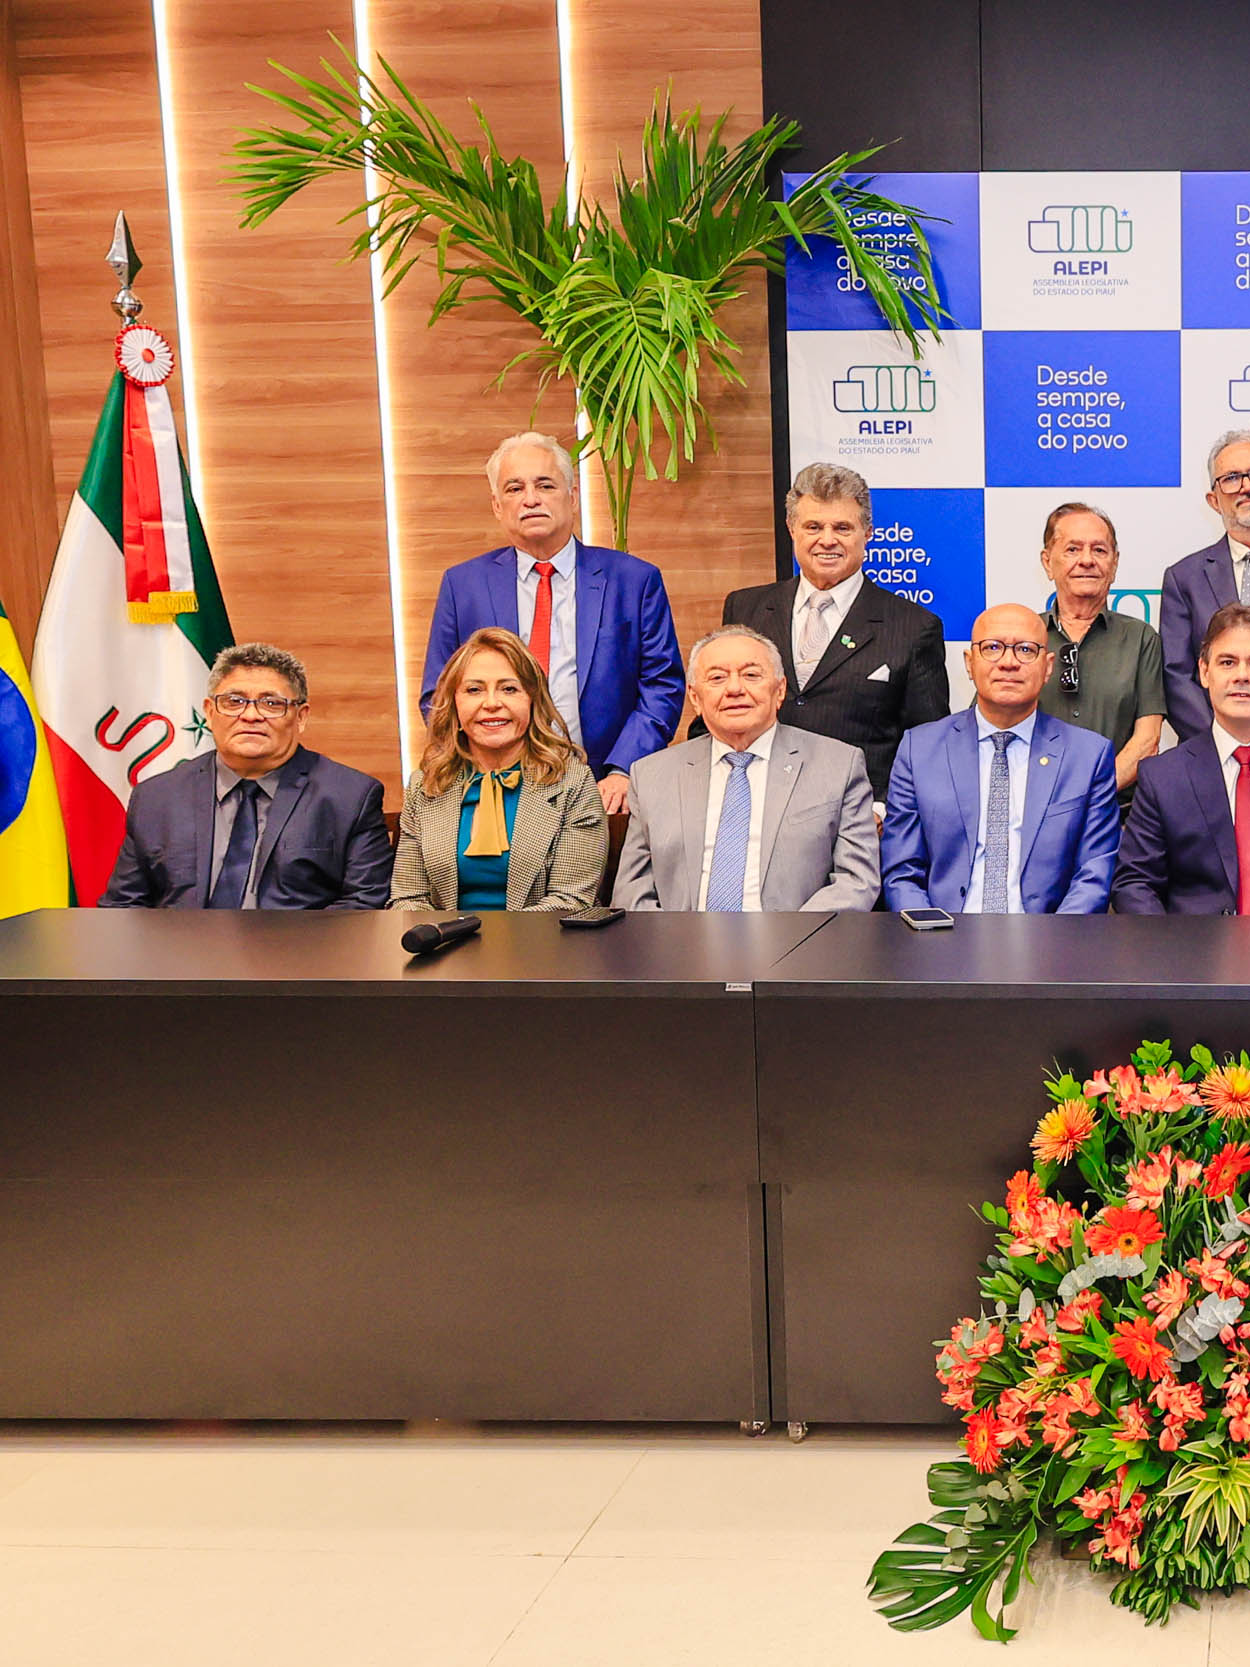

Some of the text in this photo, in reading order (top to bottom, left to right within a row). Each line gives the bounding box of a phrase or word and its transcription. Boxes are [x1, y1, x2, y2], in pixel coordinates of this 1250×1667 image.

[1053, 260, 1108, 275] ALEPI
[1235, 253, 1250, 268] a
[837, 271, 866, 291] do
[1033, 279, 1129, 287] ASSEMBLEIA LEGISLATIVA
[1033, 288, 1046, 296] DO
[1048, 288, 1079, 296] ESTADO
[1081, 288, 1094, 296] DO
[1037, 364, 1108, 386] Desde
[1036, 392, 1126, 411] sempre,
[859, 420, 912, 435] ALEPI
[1037, 413, 1111, 428] a casa
[838, 437, 933, 445] ASSEMBLEIA LEGISLATIVA
[1037, 429, 1128, 454] do povo
[838, 447, 851, 455] DO
[853, 447, 884, 455] ESTADO
[886, 447, 899, 455] DO
